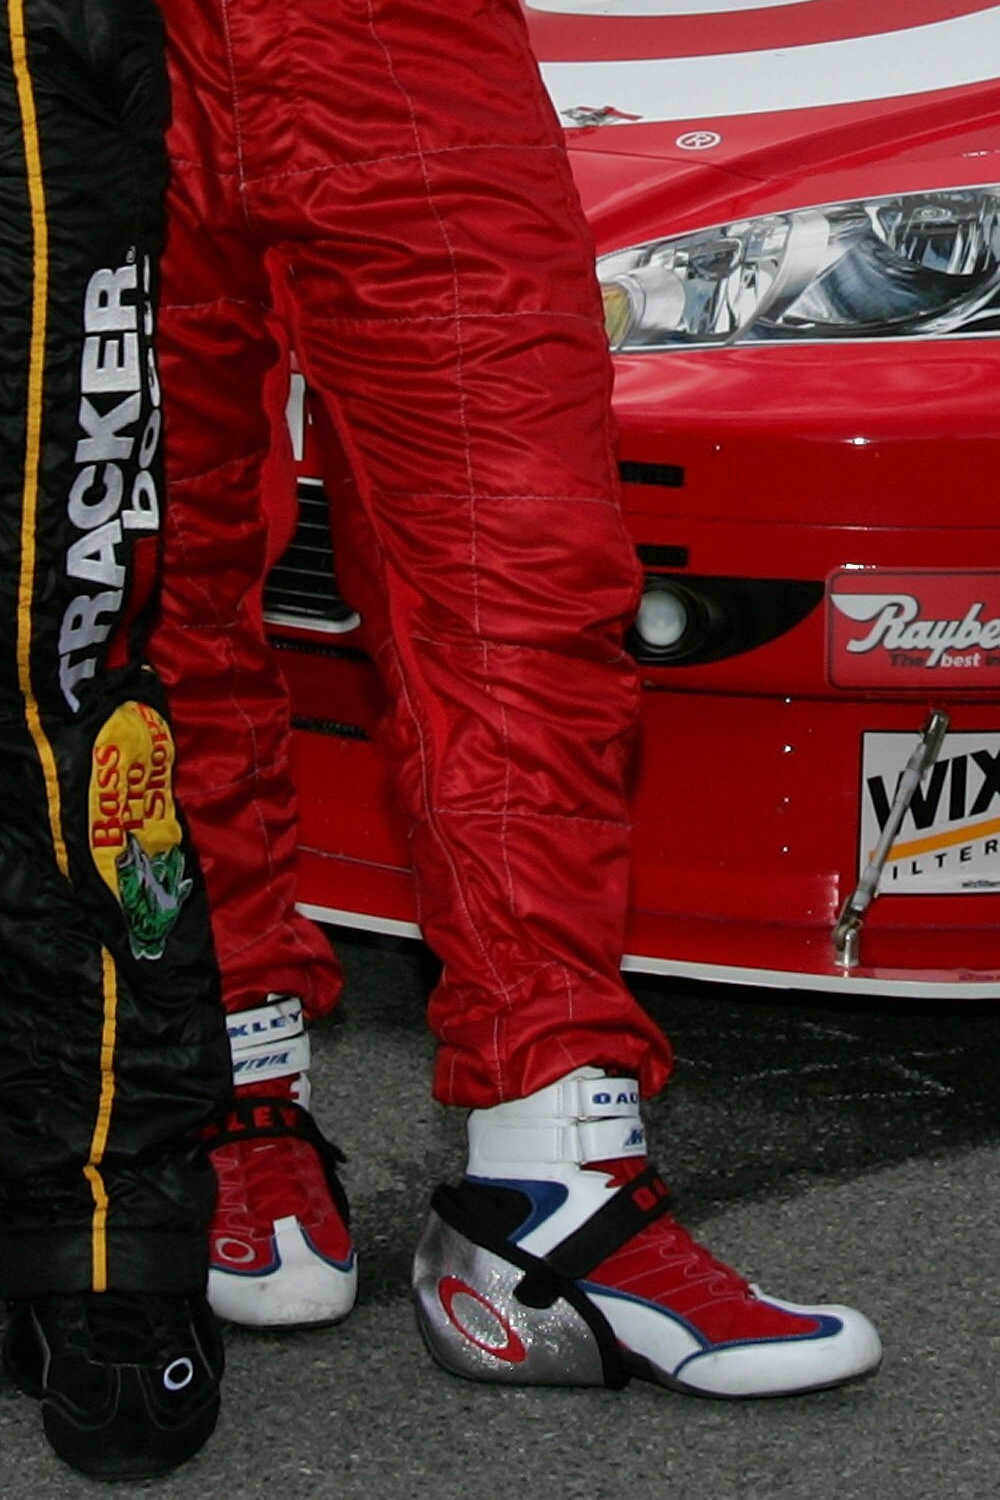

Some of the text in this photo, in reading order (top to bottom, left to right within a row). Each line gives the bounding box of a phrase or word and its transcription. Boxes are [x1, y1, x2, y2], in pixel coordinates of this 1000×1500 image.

[57, 264, 142, 714] TRACKER
[940, 652, 981, 668] best
[92, 744, 124, 848] Bass
[122, 762, 146, 831] Pro
[866, 748, 1000, 838] WIX
[891, 838, 999, 882] ILTER
[227, 1010, 302, 1038] KLEY
